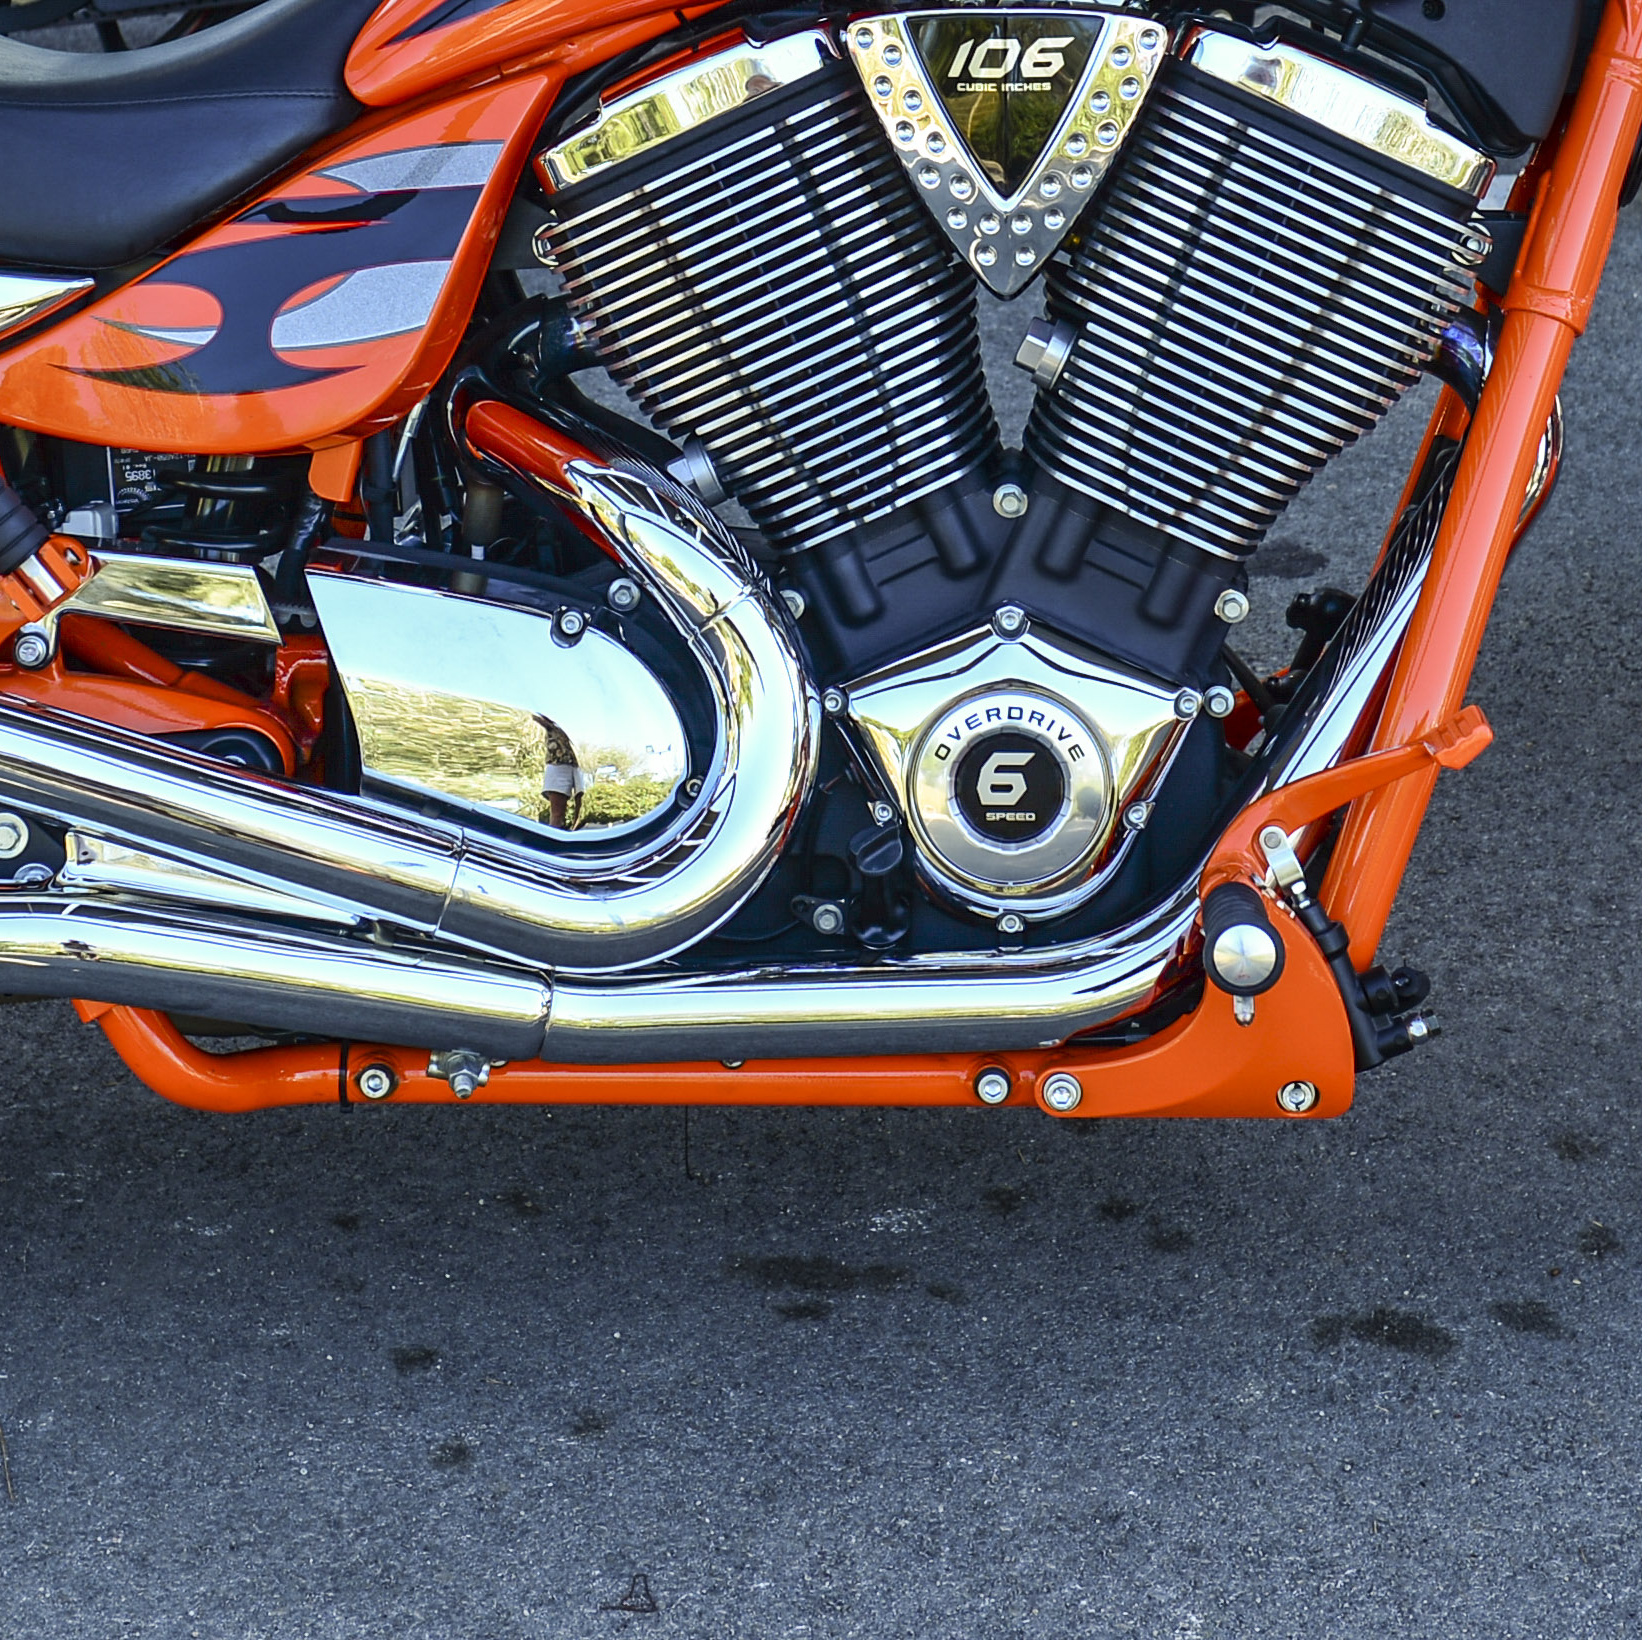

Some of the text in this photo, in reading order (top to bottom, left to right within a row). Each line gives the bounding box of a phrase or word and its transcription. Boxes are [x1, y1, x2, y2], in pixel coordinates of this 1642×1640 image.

[947, 36, 1076, 78] 106
[956, 81, 1052, 92] CUBIC INCHES
[934, 705, 1086, 763] OVERDRIVE
[975, 751, 1037, 806] 6
[985, 811, 1037, 822] SPEED
